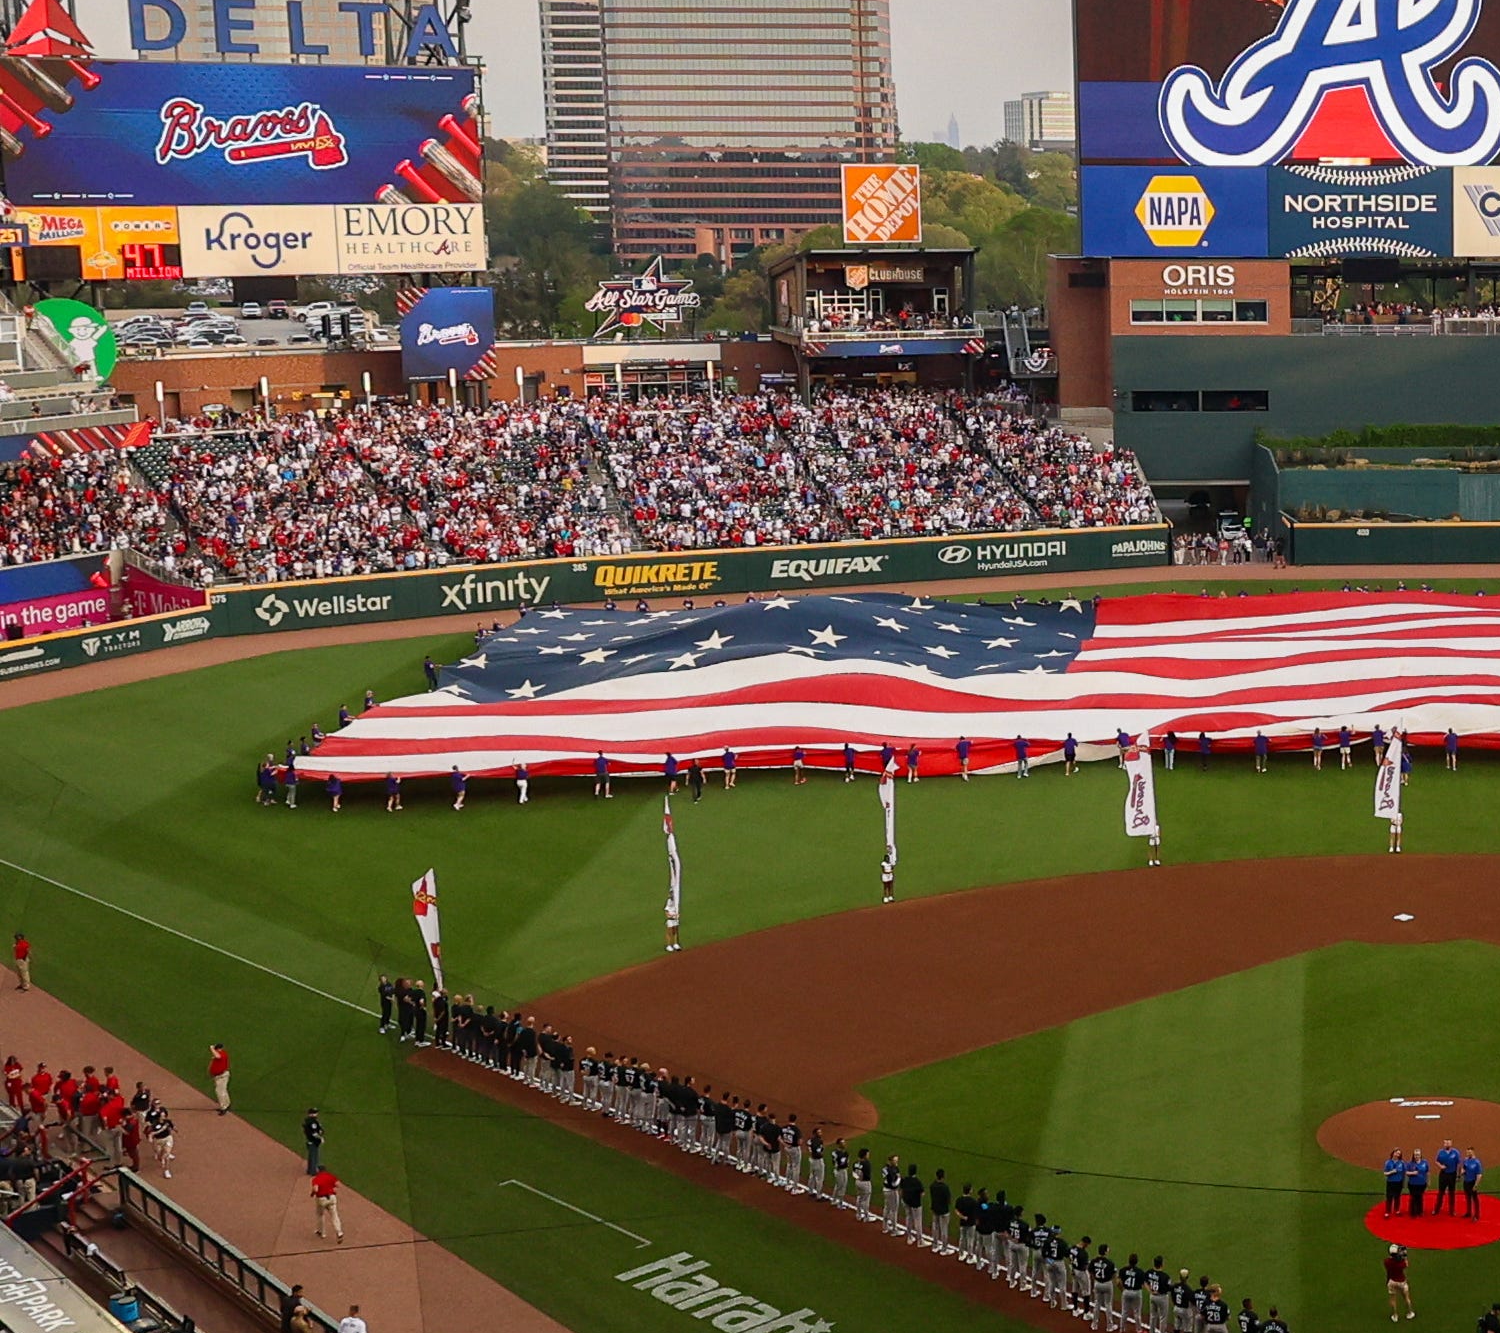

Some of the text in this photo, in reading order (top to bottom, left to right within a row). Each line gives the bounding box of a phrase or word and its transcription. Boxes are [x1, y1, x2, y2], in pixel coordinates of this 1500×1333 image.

[156, 97, 313, 165] Braves
[851, 173, 883, 204] THE
[846, 167, 918, 241] HOME
[1149, 196, 1202, 226] NAPA
[1284, 194, 1438, 213] NORTHSIDE
[41, 215, 84, 231] MEGA
[344, 206, 475, 236] EMORY
[875, 194, 919, 241] DEPOT
[1312, 216, 1410, 229] HOSPITAL
[204, 212, 313, 268] Kroger
[346, 239, 472, 256] HEALTHCARE
[124, 243, 162, 267] 47
[126, 267, 181, 279] MILLION
[868, 267, 923, 280] CLUBHOUSE
[1162, 264, 1235, 287] ORIS
[585, 288, 700, 312] All Star Game
[977, 541, 1066, 560] HYUNDAI
[594, 560, 719, 586] QUIKRETE
[770, 554, 884, 581] EQUIFAX
[977, 559, 1048, 571] HyundaiUSA.com
[211, 595, 226, 605] 375
[441, 571, 550, 610] xfinity
[21, 605, 53, 626] the
[56, 597, 106, 623] game
[293, 593, 391, 618] Wellstar
[102, 630, 141, 643] TYM
[23, 1295, 76, 1333] PARK
